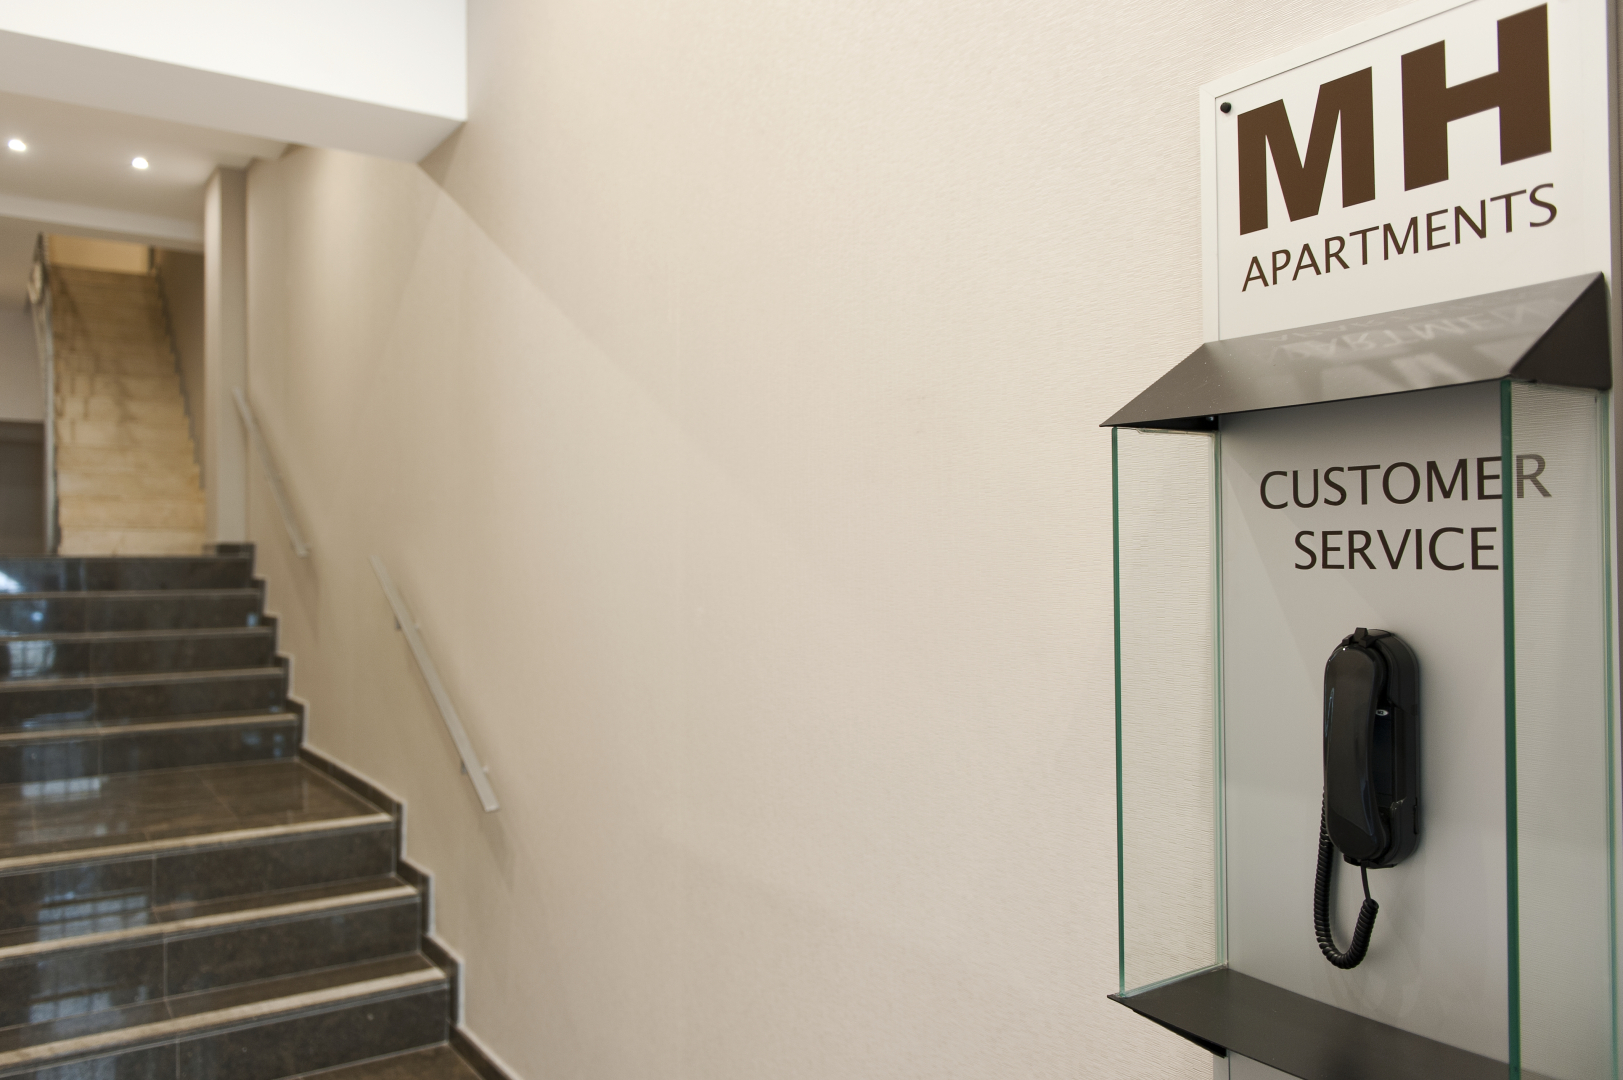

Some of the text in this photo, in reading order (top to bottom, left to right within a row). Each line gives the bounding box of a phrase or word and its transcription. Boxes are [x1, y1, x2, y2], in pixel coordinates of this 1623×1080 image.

[1237, 3, 1552, 236] MH
[1241, 182, 1558, 293] APARTMENTS
[1259, 453, 1553, 510] CUSTOMER
[1294, 526, 1499, 571] SERVICE
